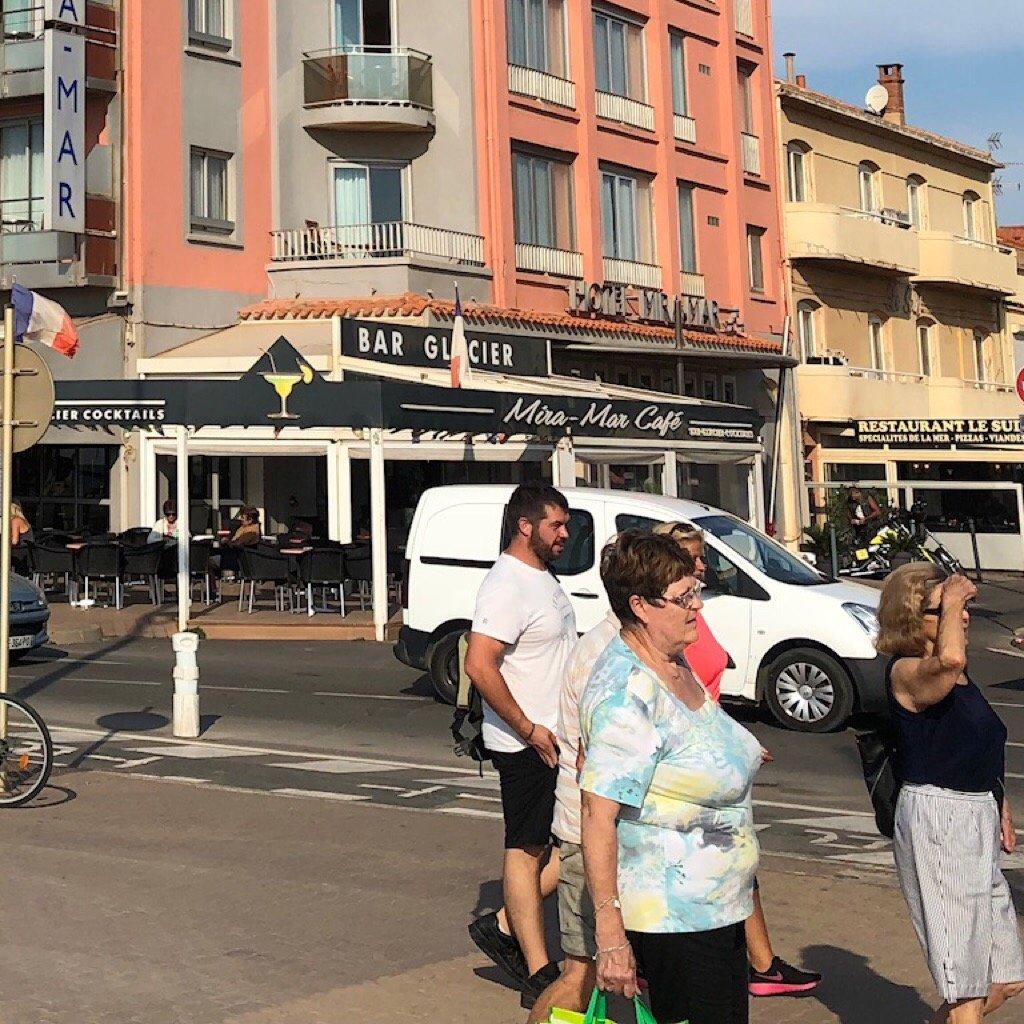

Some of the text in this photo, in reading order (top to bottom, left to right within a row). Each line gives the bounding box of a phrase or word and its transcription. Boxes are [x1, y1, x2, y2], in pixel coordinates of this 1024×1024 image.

[358, 327, 513, 367] BAR GLCIER
[83, 409, 165, 421] COCKTAILS
[503, 397, 684, 436] Mira-Mar Café
[858, 420, 965, 433] RESTAURANT
[968, 420, 988, 433] LE
[908, 434, 920, 443] DE
[921, 434, 932, 443] LA
[932, 434, 949, 443] MER
[955, 434, 984, 443] PIZZAS
